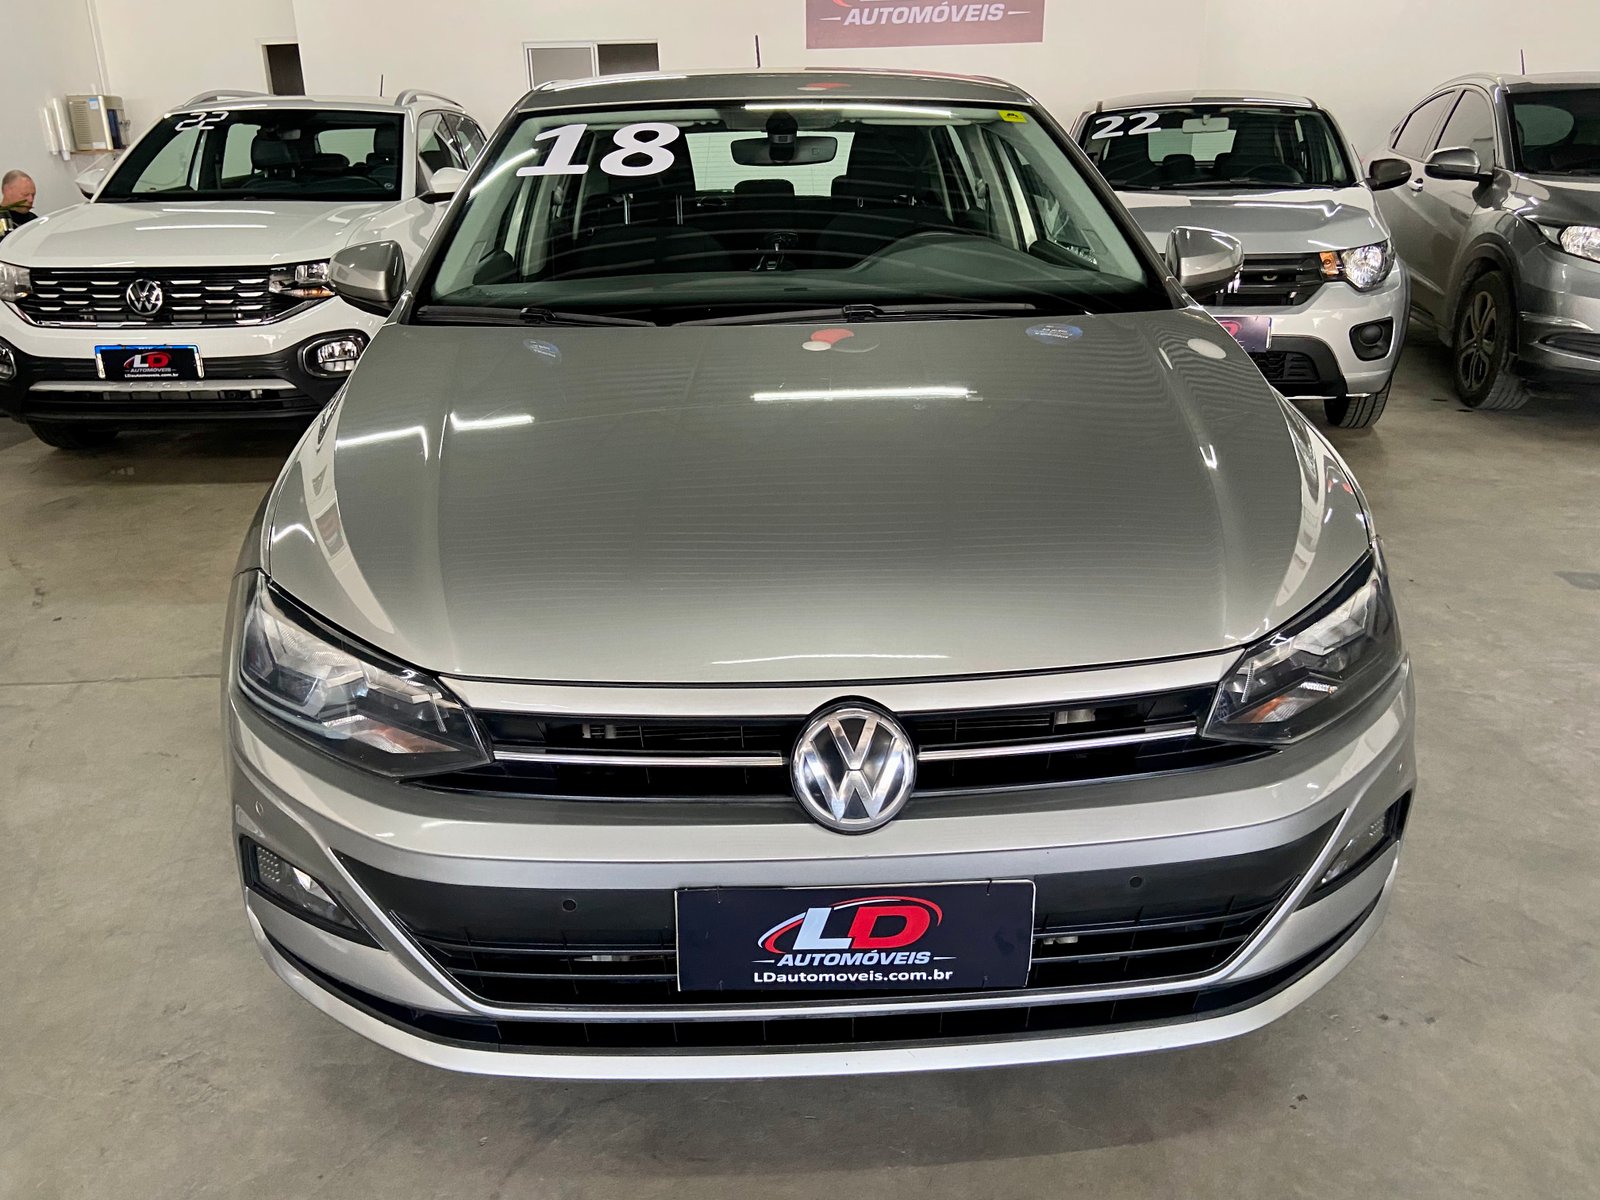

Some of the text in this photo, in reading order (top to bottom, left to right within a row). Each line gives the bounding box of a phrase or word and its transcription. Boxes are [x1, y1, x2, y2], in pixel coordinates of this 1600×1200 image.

[843, 2, 1005, 26] AUTOMÓVEIS
[174, 111, 230, 131] 22
[1091, 112, 1162, 140] 22
[516, 122, 680, 177] 18
[133, 354, 169, 368] LD
[793, 906, 931, 950] LD
[777, 950, 931, 967] AUTOMÓVEIS
[754, 969, 953, 983] LDautomoveis.com.br
